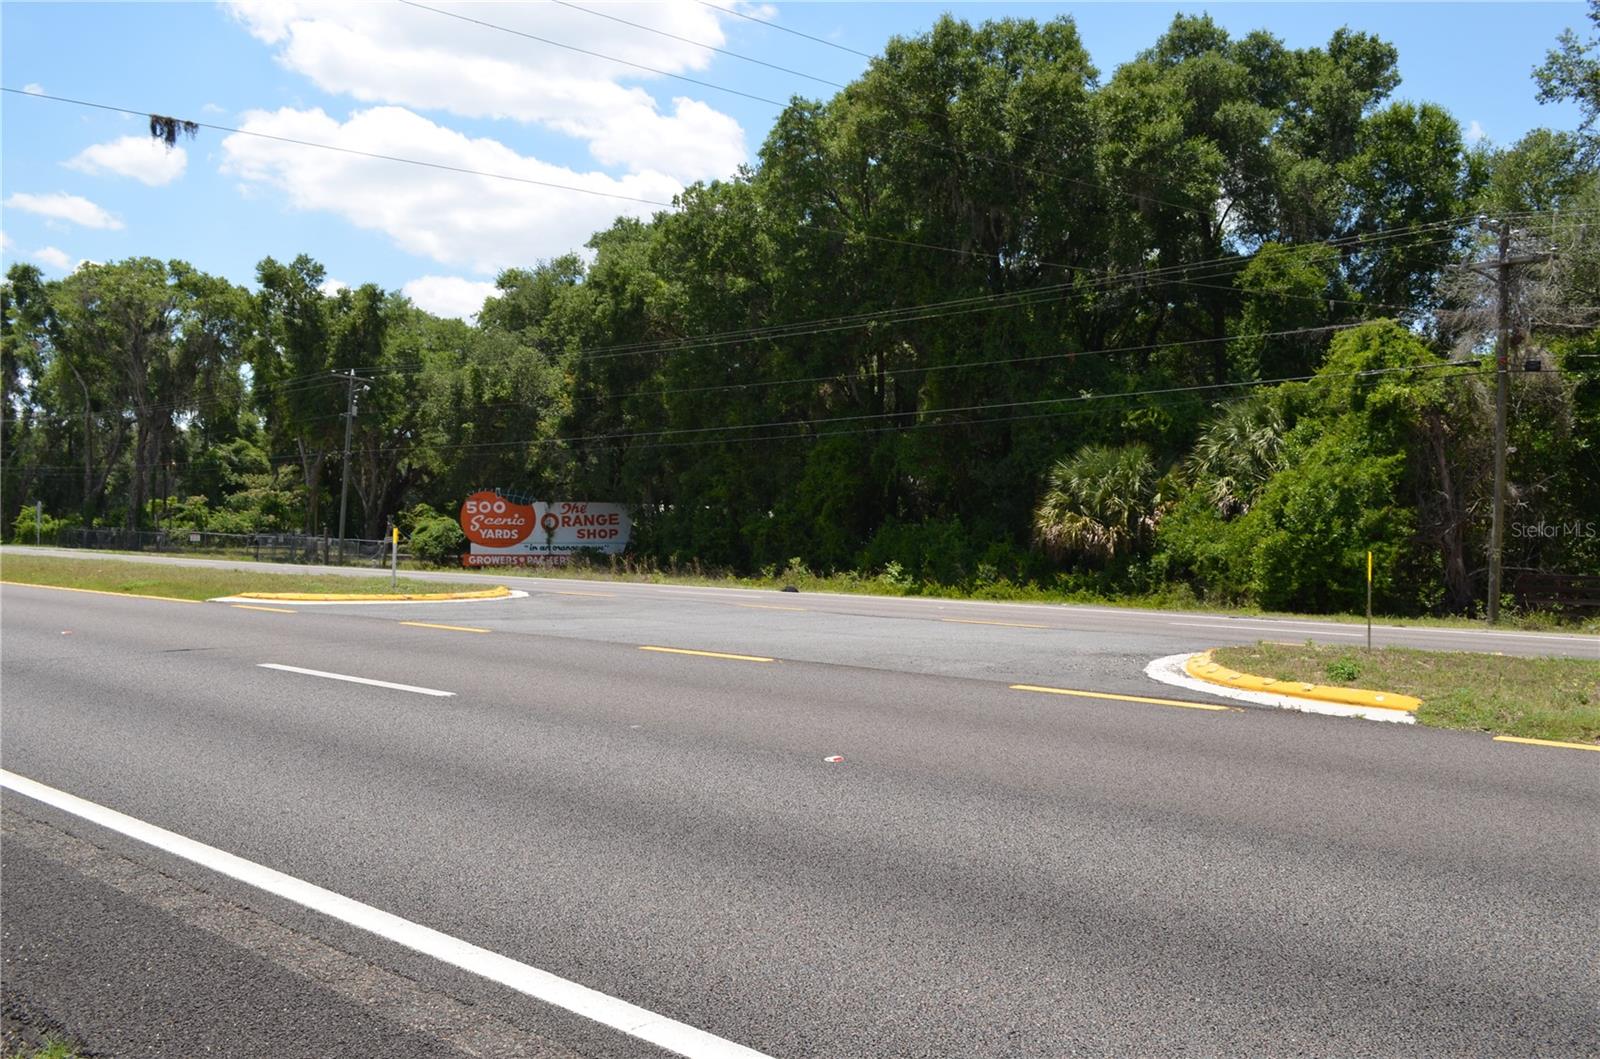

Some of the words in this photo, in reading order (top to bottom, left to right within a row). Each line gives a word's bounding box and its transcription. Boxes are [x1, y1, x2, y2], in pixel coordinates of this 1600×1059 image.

[466, 501, 506, 514] 500
[561, 503, 587, 514] The
[470, 513, 526, 532] Scenic
[540, 513, 620, 532] ORANGE
[479, 529, 519, 539] YARDS
[576, 528, 619, 539] SHOP
[468, 555, 518, 565] GROWERS
